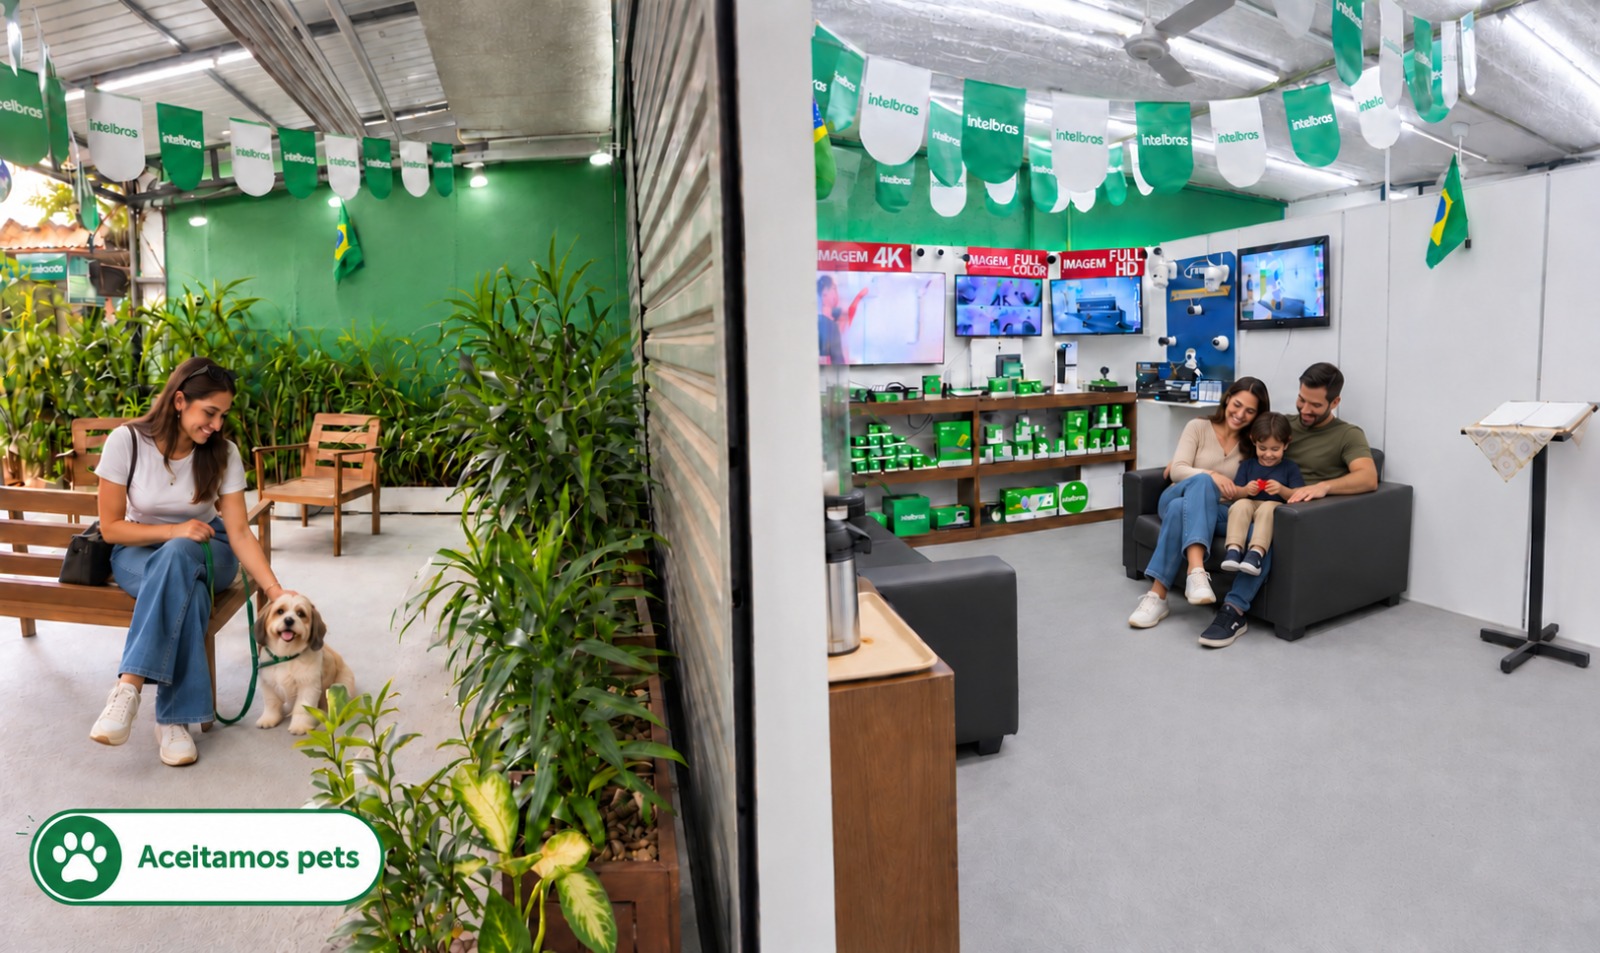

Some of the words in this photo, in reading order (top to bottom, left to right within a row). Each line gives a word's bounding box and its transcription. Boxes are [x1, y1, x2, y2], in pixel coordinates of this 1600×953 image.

[868, 92, 919, 116] intelbras
[89, 118, 138, 138] intelbras
[967, 114, 1019, 135] intelbras
[1291, 114, 1334, 131] intelbras
[162, 132, 202, 149] intelbras
[1056, 128, 1104, 145] intelbras
[1141, 134, 1189, 146] intelbras
[1218, 131, 1260, 144] intelbras
[818, 249, 868, 263] MAGEM
[872, 246, 905, 268] 4K
[968, 254, 1008, 266] MAGEM
[1014, 253, 1041, 265] FULL
[1063, 258, 1106, 269] IMAGEM
[1109, 248, 1144, 262] FULL
[1012, 264, 1047, 276] COLOR
[1115, 261, 1138, 276] HD
